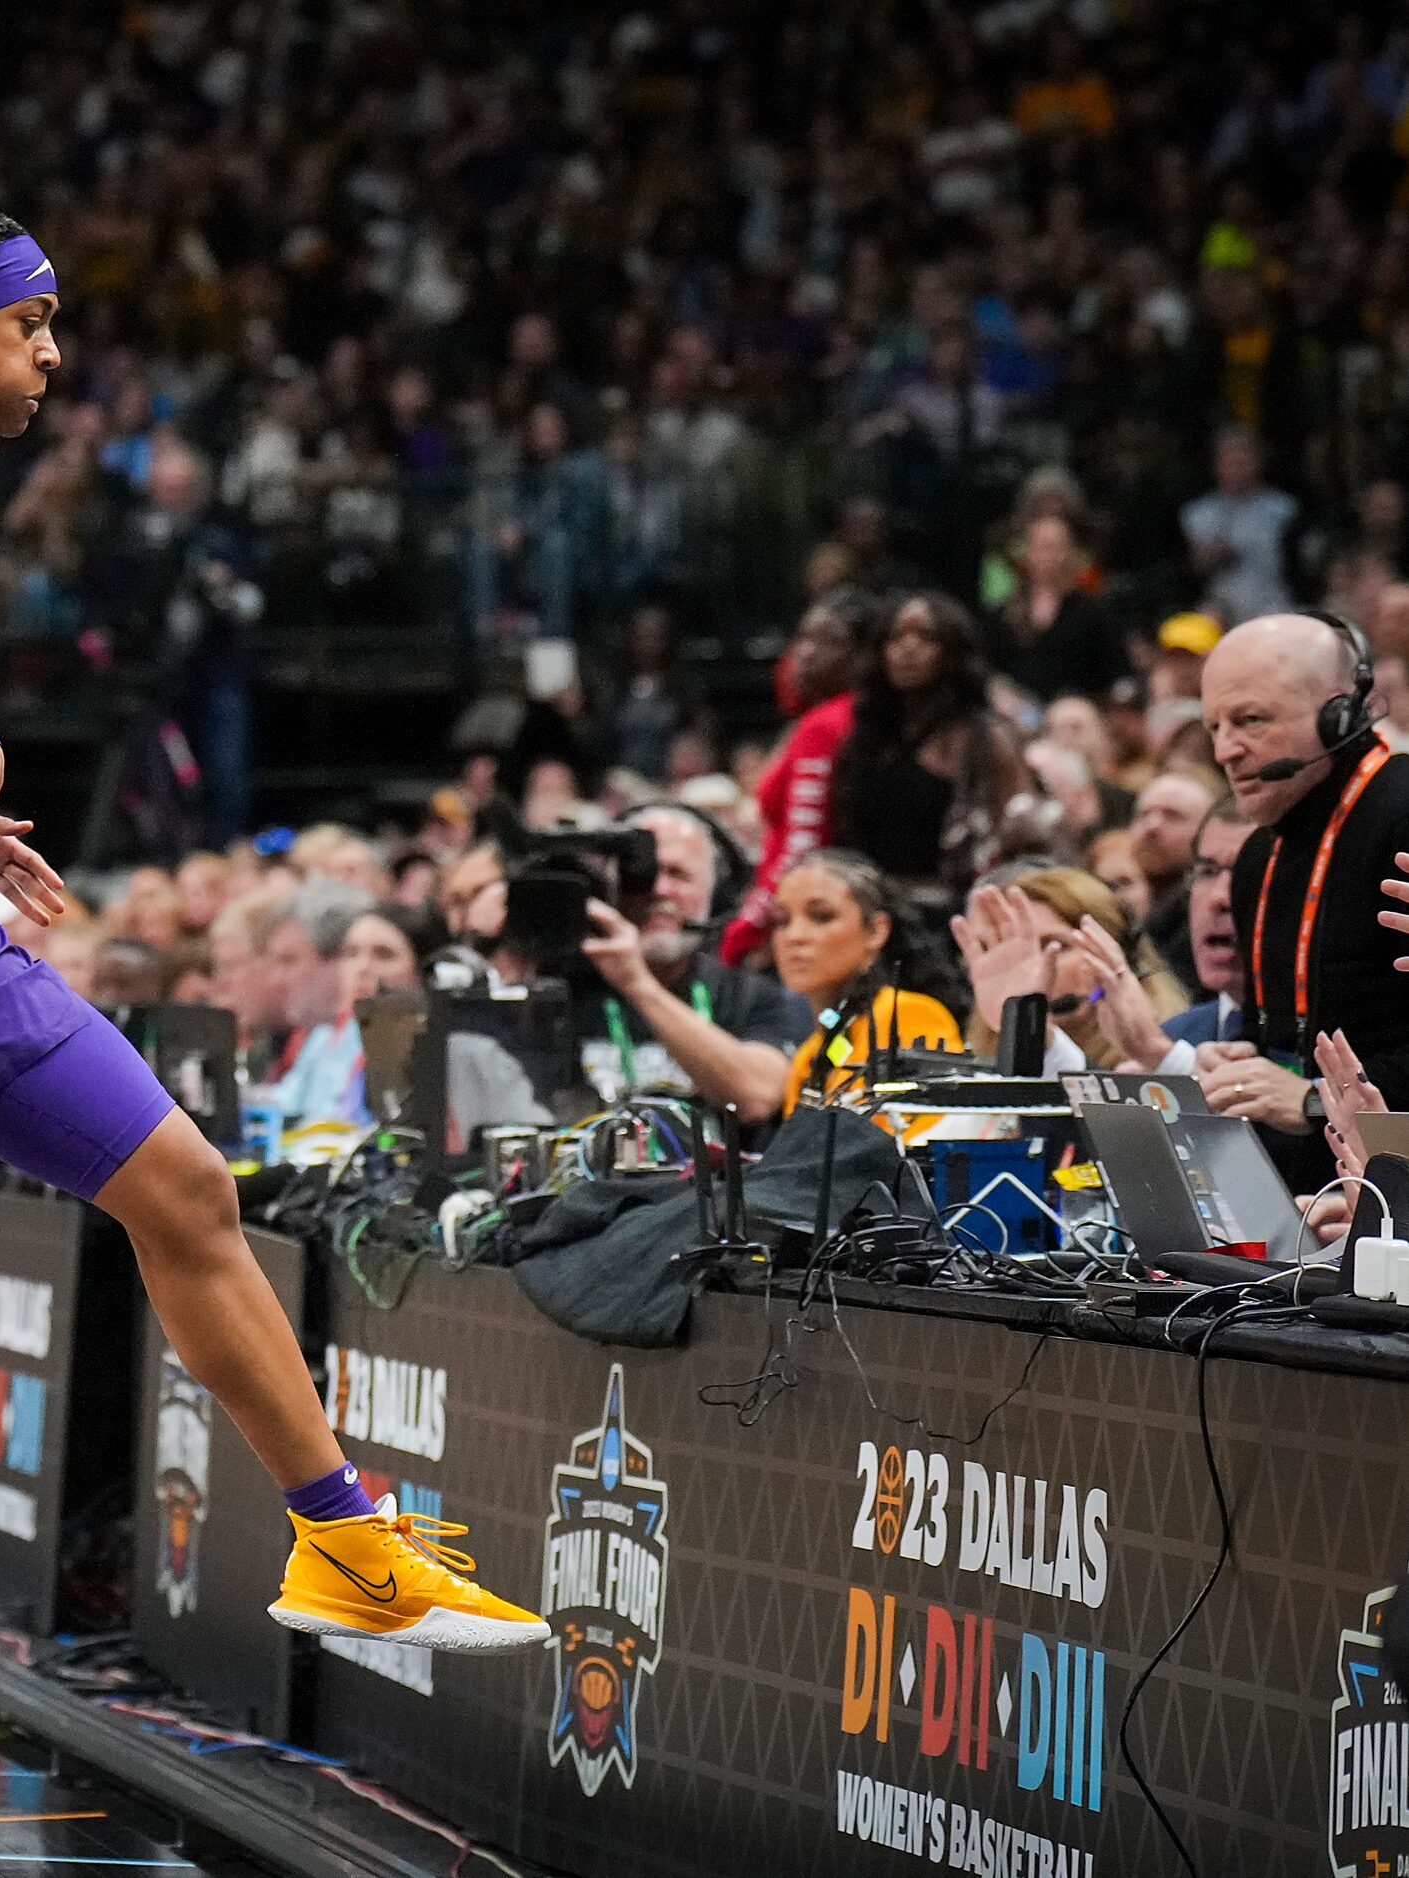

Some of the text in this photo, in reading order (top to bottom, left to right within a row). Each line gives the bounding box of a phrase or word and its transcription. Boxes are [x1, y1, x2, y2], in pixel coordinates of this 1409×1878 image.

[540, 1528, 661, 1641] FINAL FOUR
[852, 1441, 1108, 1609] 2023 DALLAS
[841, 1587, 1106, 1813] DI DII DIII
[837, 1770, 946, 1863] WOMEN'S
